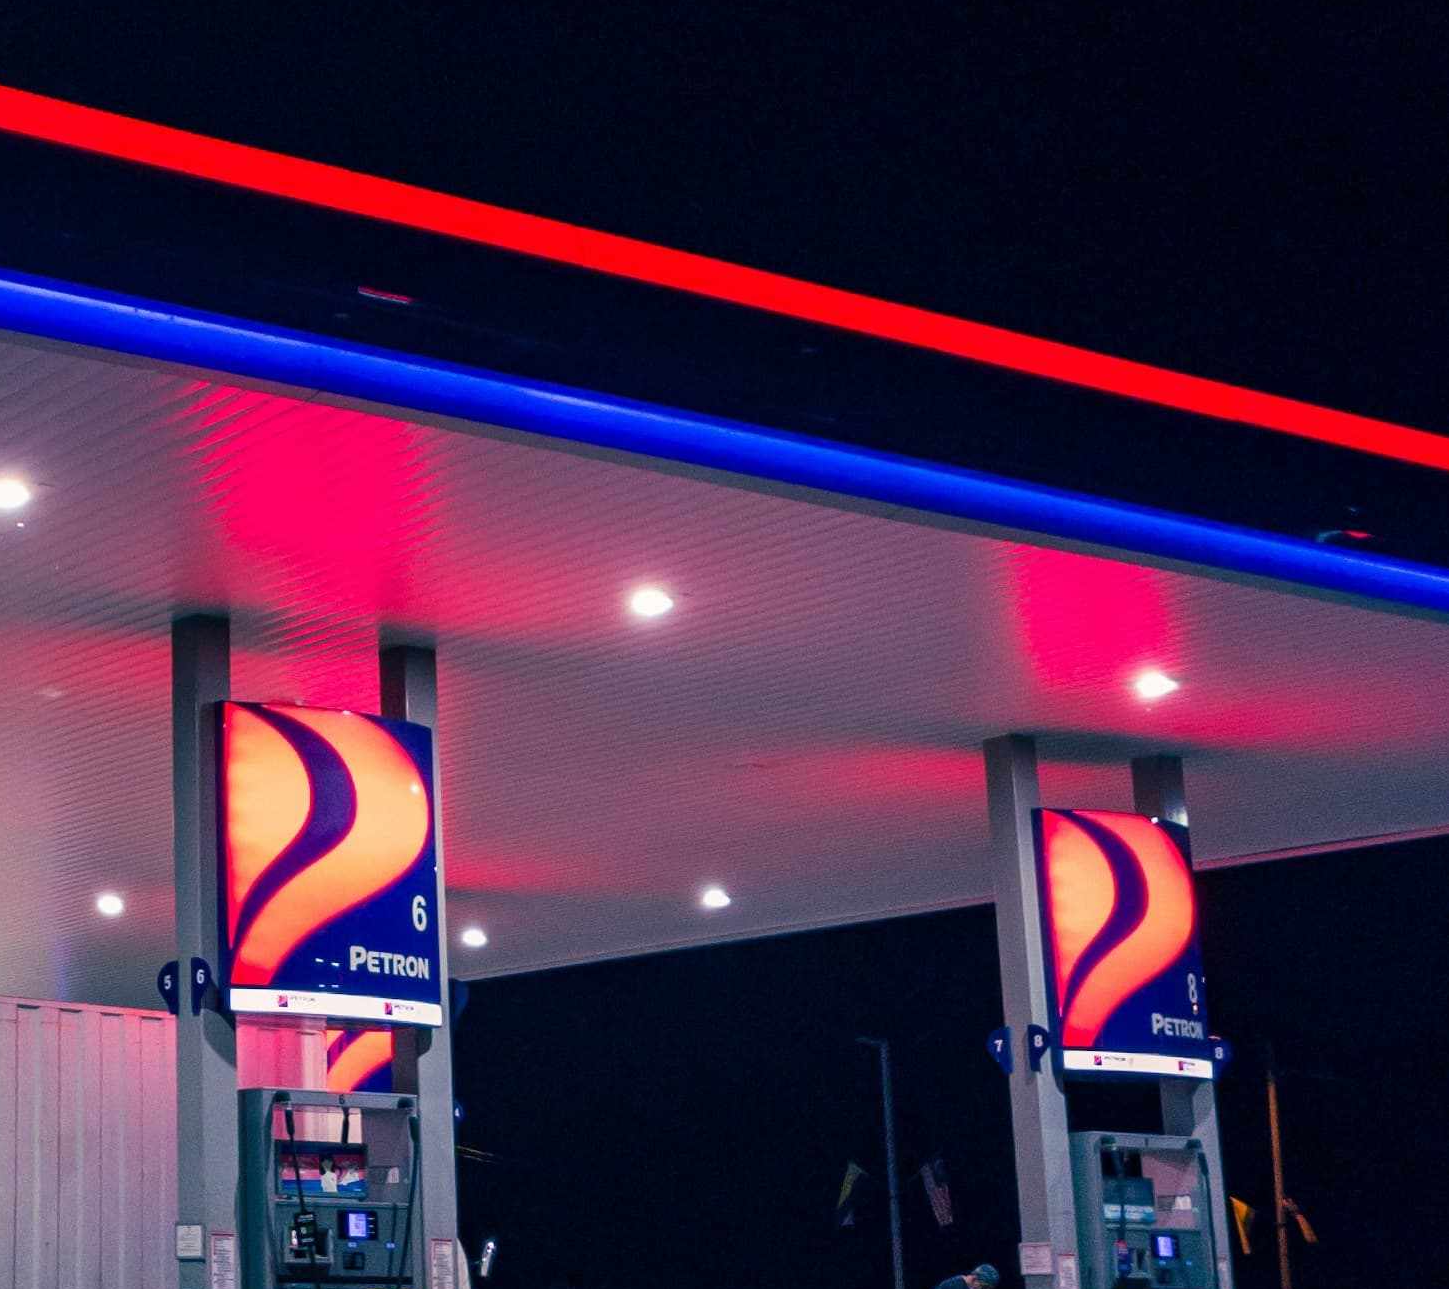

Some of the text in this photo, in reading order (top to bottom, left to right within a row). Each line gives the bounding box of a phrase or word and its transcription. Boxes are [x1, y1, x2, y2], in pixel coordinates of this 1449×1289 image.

[412, 894, 428, 932] 6
[349, 945, 430, 981] PETRON
[163, 975, 172, 990] 5
[196, 969, 205, 984] 6
[1187, 972, 1198, 1004] 8
[1151, 1013, 1203, 1040] PETRON
[994, 1039, 1003, 1052] 7
[1033, 1034, 1043, 1048] 8
